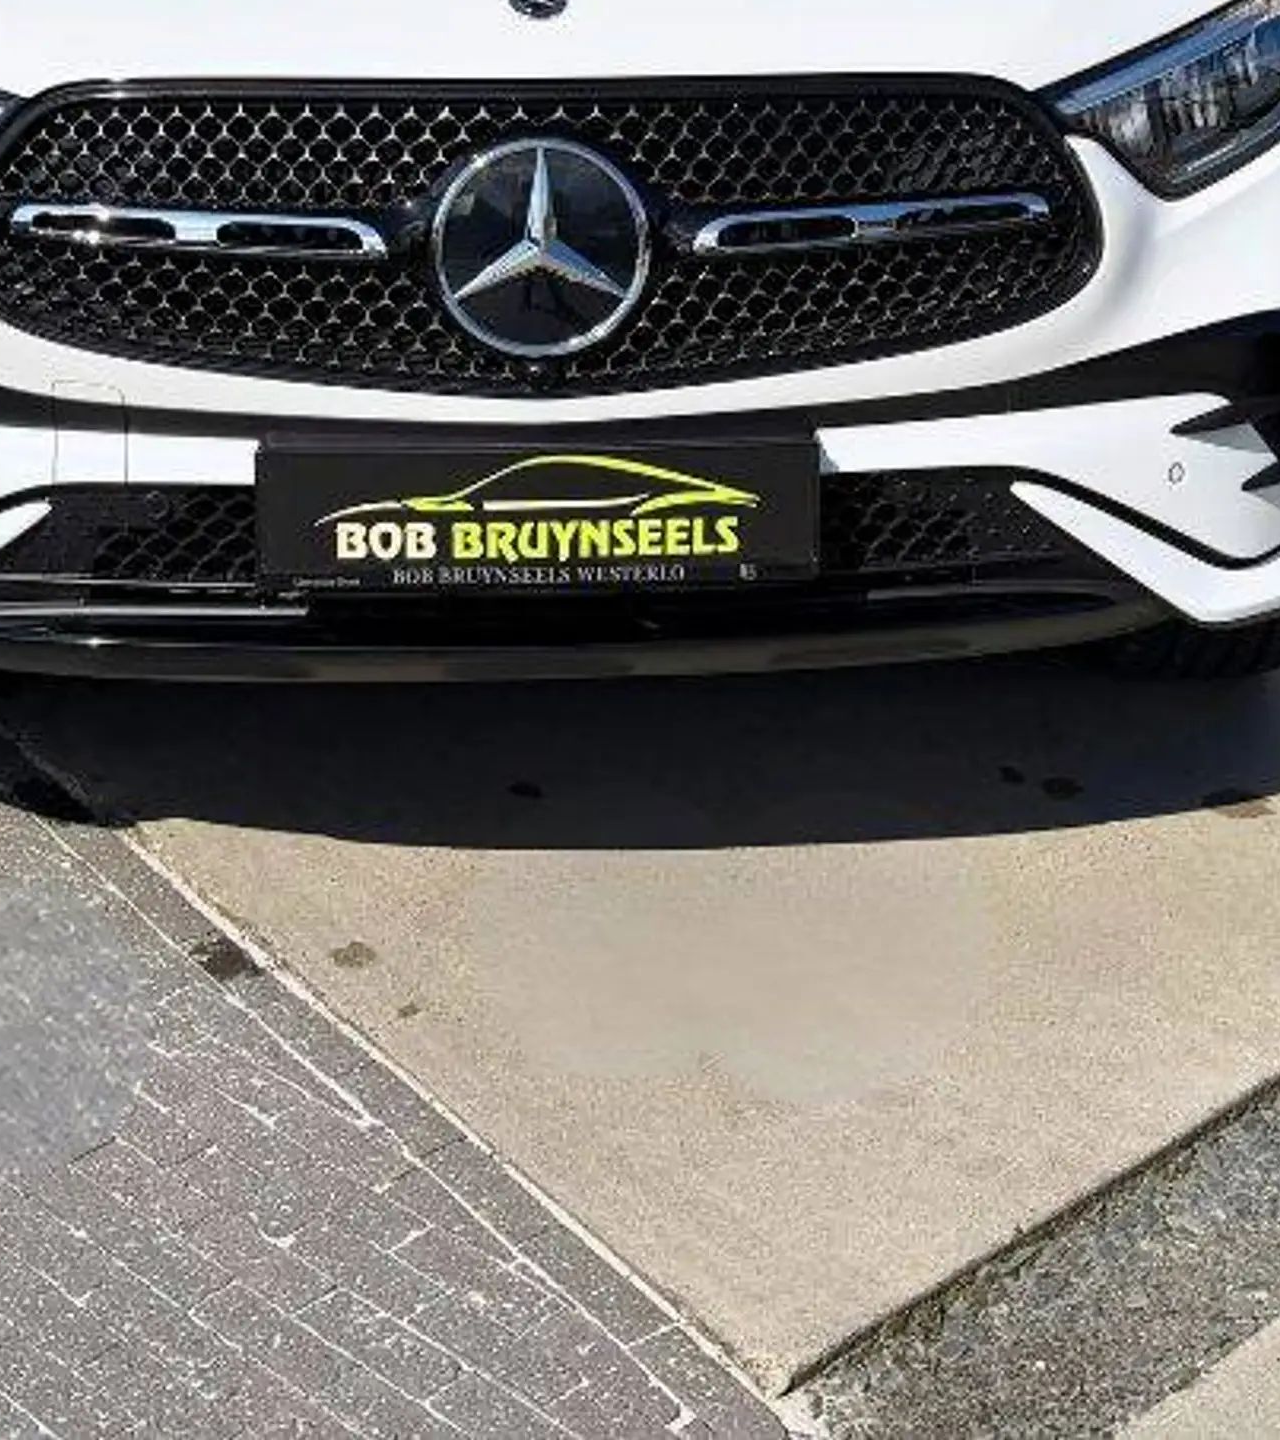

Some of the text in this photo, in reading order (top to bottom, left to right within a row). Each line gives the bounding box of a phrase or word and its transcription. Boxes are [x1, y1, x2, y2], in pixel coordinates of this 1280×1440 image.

[336, 516, 740, 563] BOB BRUYNSEELS
[392, 567, 434, 585] BOB
